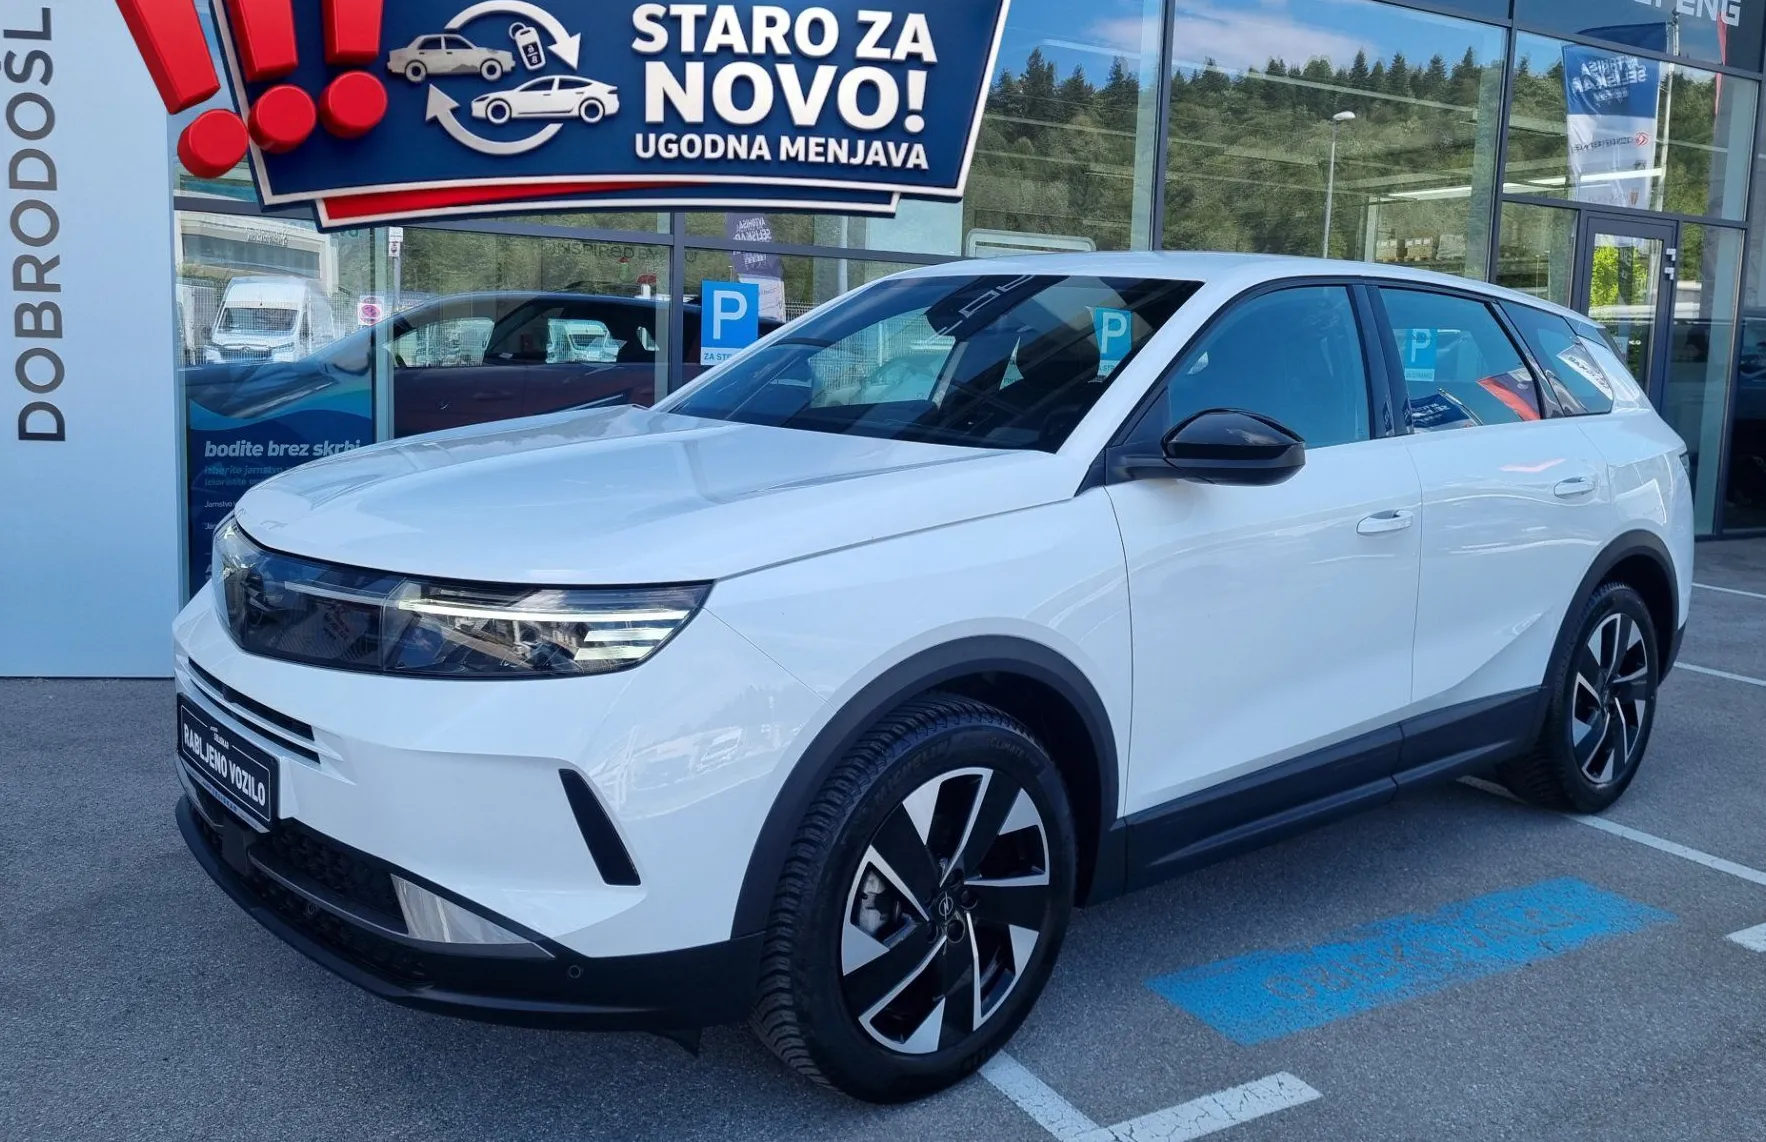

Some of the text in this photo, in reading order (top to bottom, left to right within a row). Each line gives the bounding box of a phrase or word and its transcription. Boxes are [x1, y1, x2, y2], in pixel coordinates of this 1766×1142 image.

[713, 290, 748, 340] P
[704, 352, 715, 360] ZA
[204, 440, 264, 457] bodite
[268, 440, 309, 457] brez
[183, 722, 228, 778] RABLJENO
[229, 760, 266, 806] VOZILO
